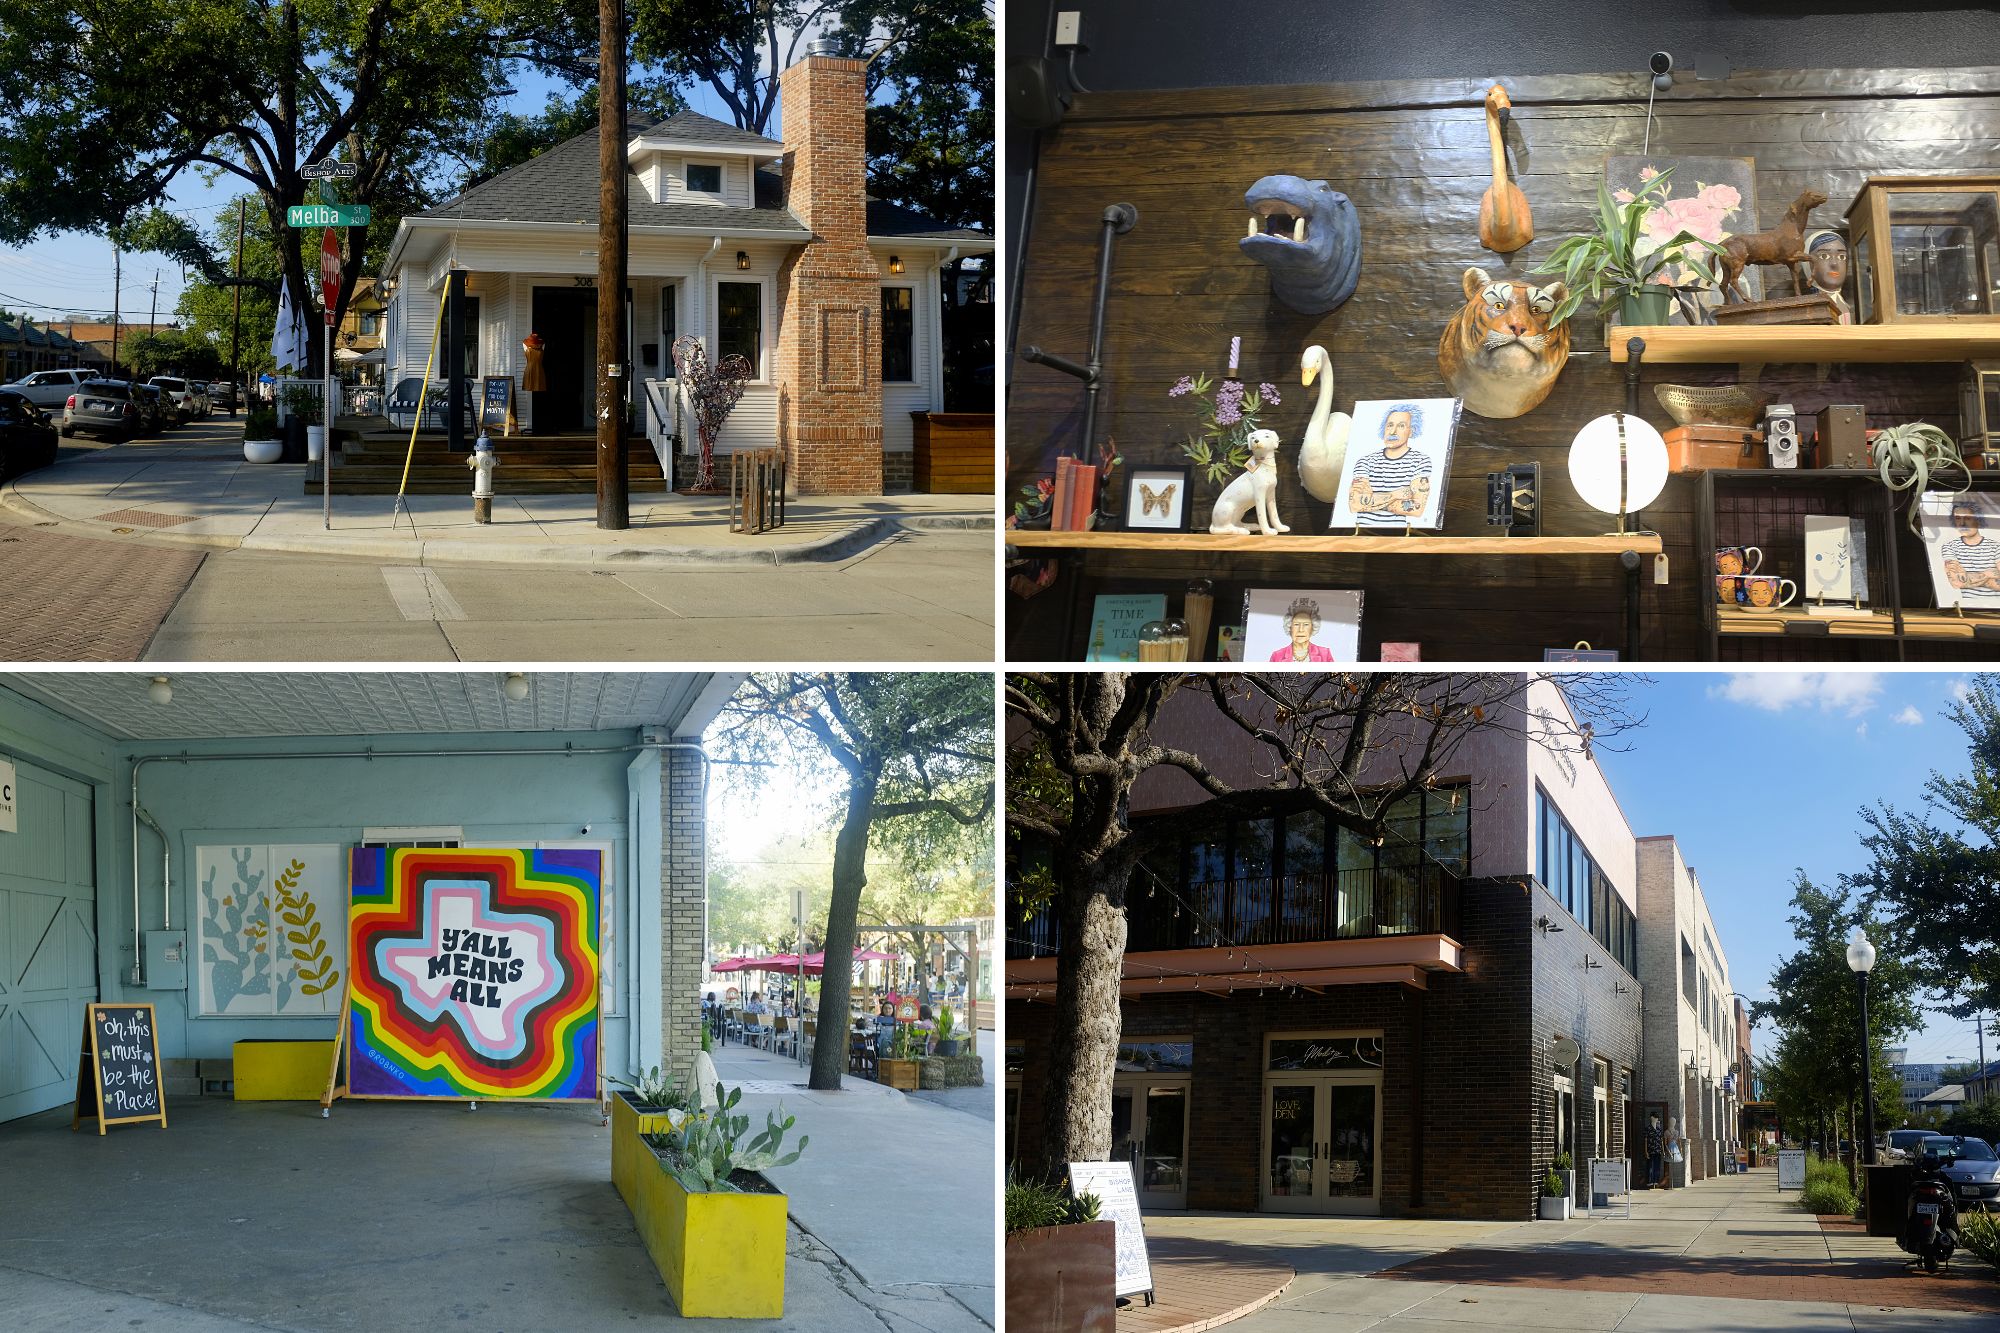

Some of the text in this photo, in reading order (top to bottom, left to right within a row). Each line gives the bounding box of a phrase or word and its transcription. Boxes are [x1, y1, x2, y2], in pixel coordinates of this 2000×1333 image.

[304, 169, 331, 177] BISHOP
[291, 207, 339, 225] Melba
[353, 206, 362, 214] St
[350, 216, 366, 224] 300
[322, 251, 339, 287] STOP
[486, 407, 505, 415] MONTH
[1111, 609, 1144, 620] TIME
[1112, 628, 1137, 639] TEA
[442, 928, 513, 959] Y'ALL
[427, 953, 525, 984] MEANS
[449, 978, 502, 1009] ALL
[127, 1017, 150, 1044] this
[111, 1044, 143, 1061] must
[102, 1064, 154, 1090] be the
[114, 1089, 157, 1111] Place!
[1108, 1178, 1131, 1186] BISHOP
